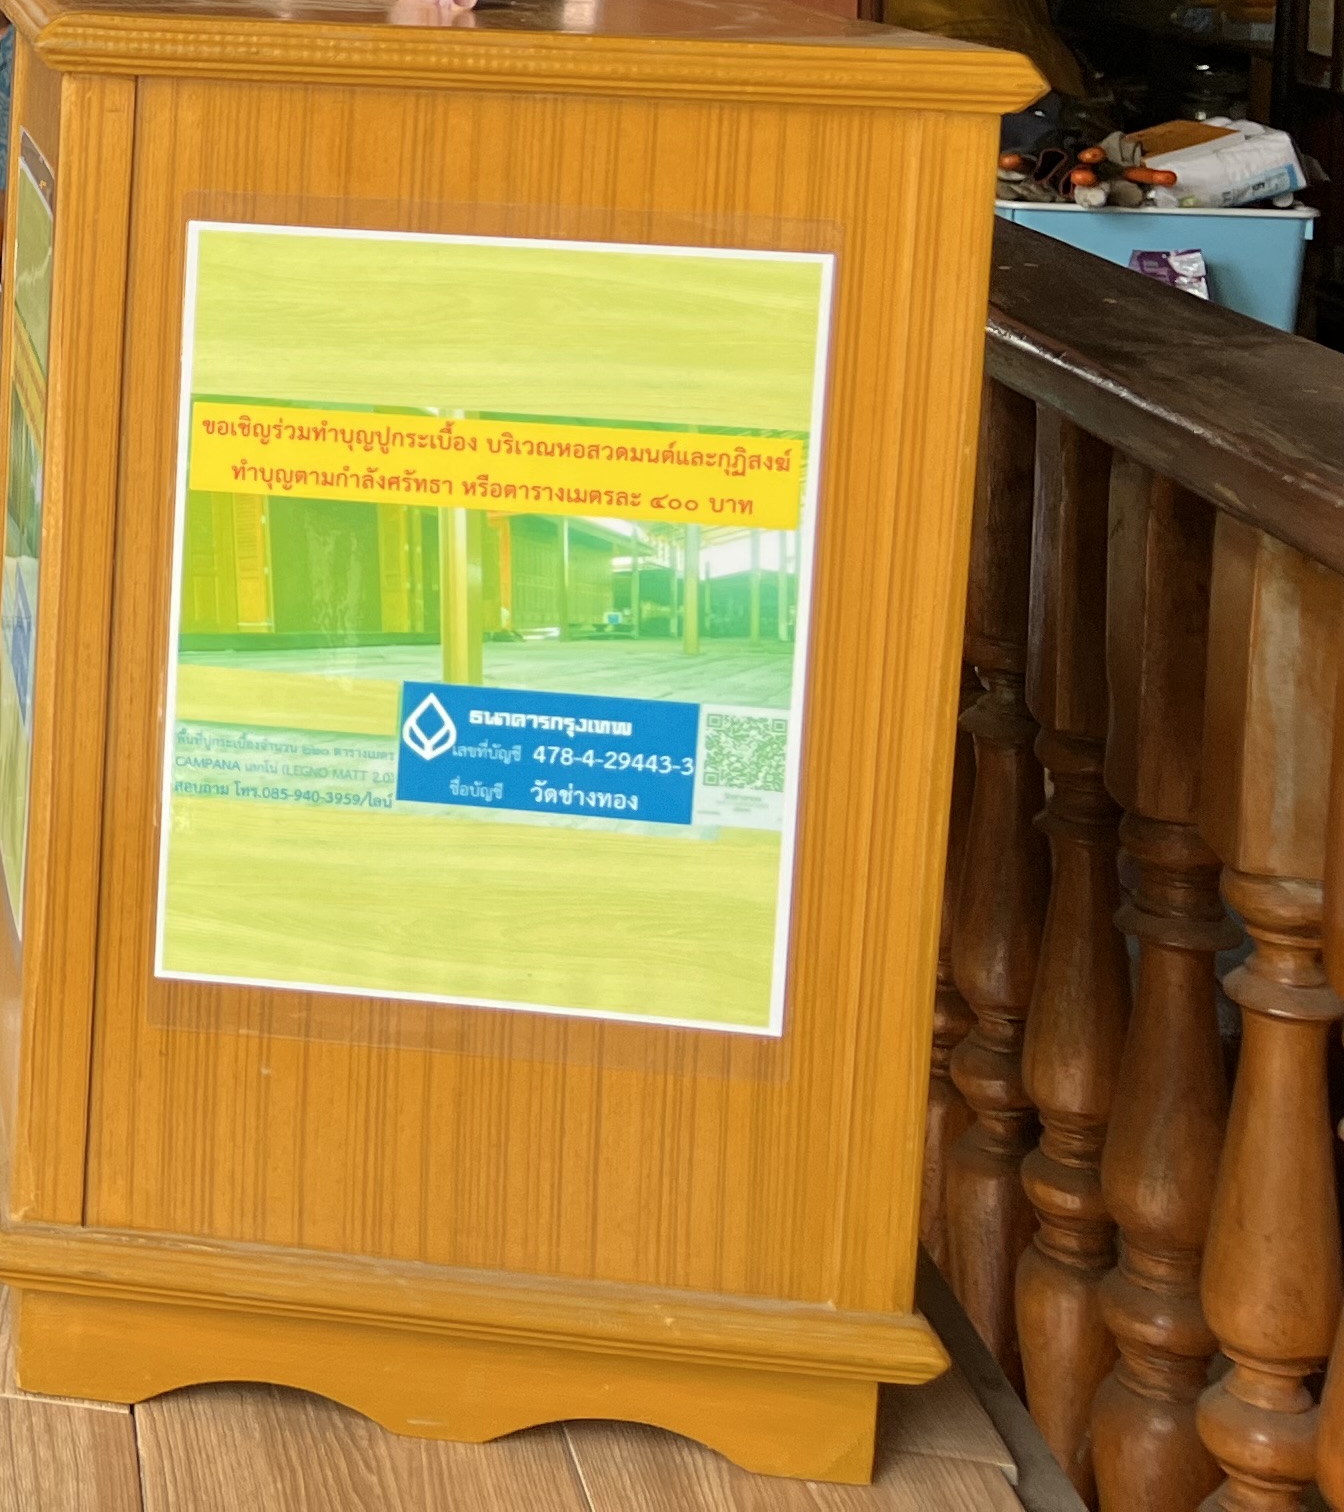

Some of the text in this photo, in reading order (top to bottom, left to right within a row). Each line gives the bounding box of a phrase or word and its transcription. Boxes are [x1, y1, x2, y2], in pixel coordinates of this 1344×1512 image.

[202, 414, 792, 477] ขอเชิญร่วมทำบุญปูกระเบื้อง บริเวณหอสวดมนต์และกุฏิสงฆ์
[231, 458, 754, 516] ทำบุญตามกำลังศรัทธา หรือตารางเมตรละ ๔๐๐ บาท
[469, 709, 633, 738] ธนาคารกรุงเทพ
[175, 756, 241, 771] CAMPANA
[282, 764, 329, 779] (LEGNO
[332, 769, 368, 781] MATT
[452, 738, 694, 776] เลขที่บัญชี 478-4-29443-3
[175, 780, 229, 796] สอบถาม
[449, 775, 639, 811] ชื่อบัญชี วัดช่างทอง
